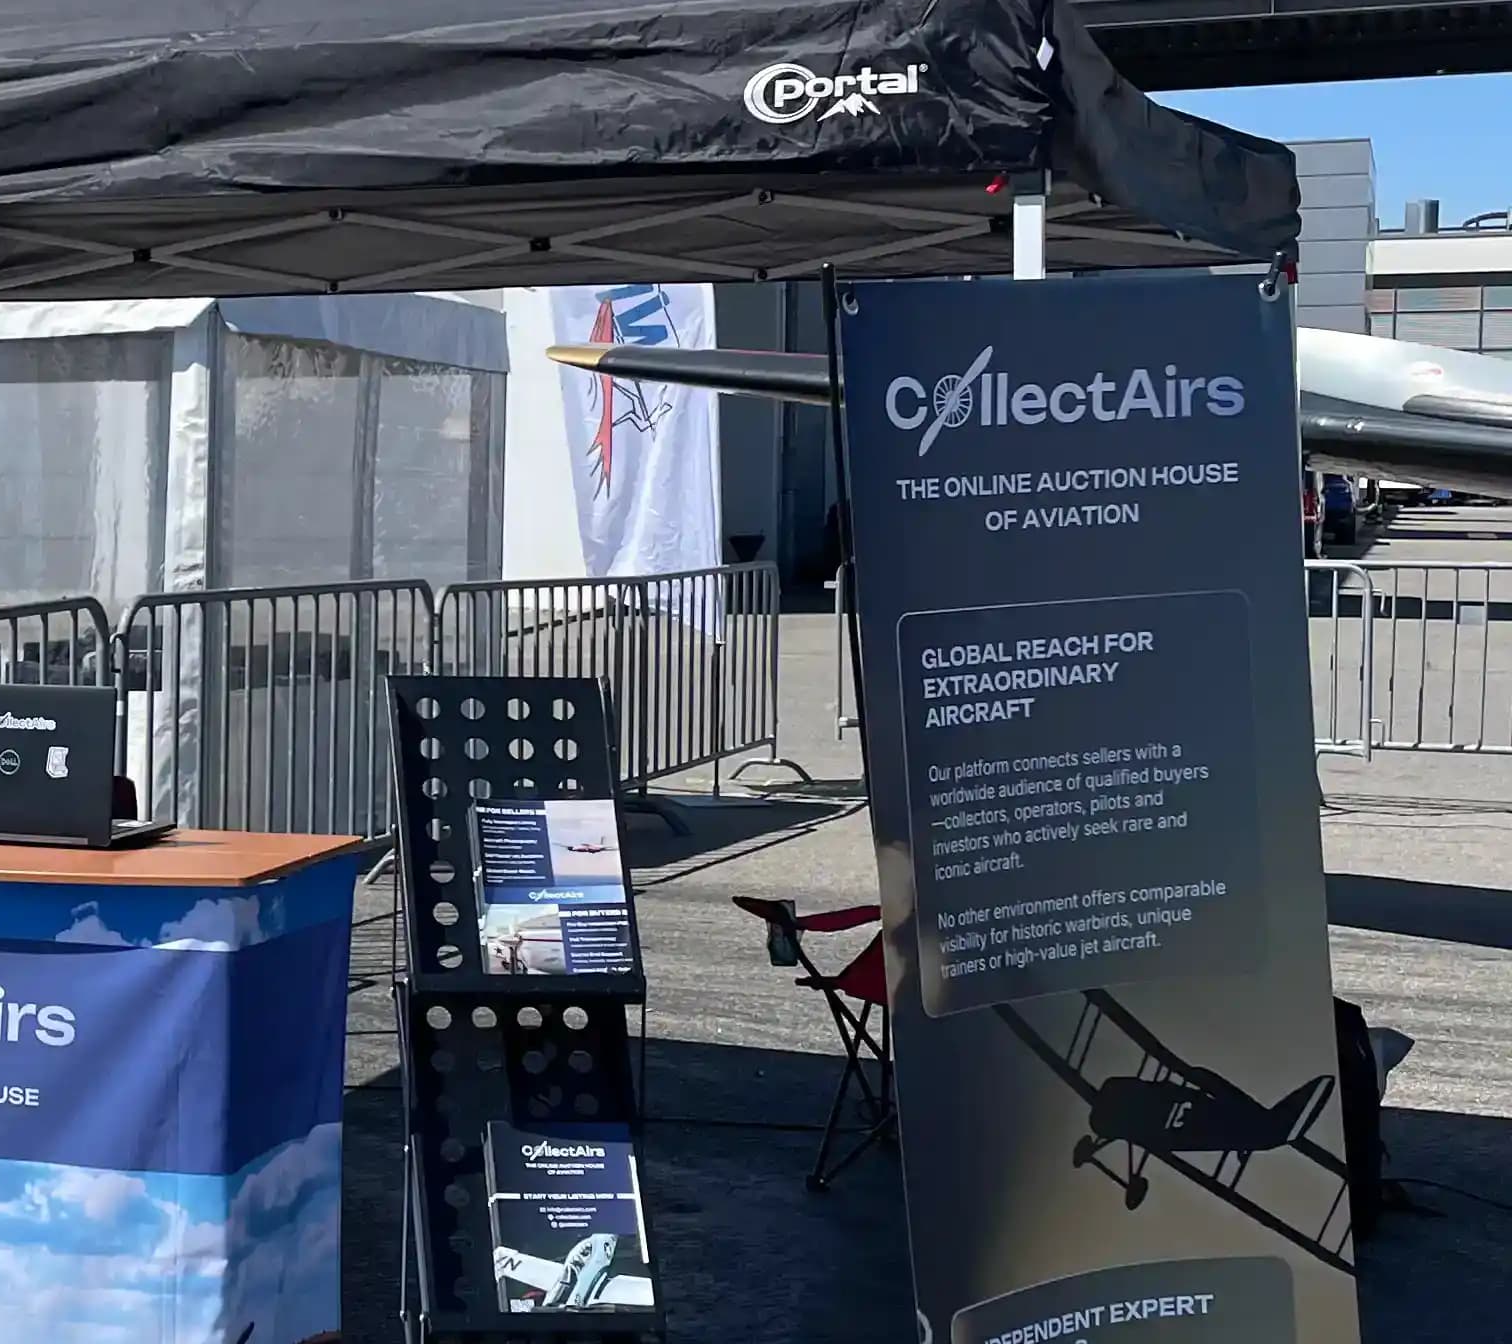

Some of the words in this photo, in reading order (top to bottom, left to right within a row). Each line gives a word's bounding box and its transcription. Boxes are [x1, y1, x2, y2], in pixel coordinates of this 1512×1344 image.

[774, 63, 919, 108] portal
[885, 345, 1245, 457] CollectAirs
[896, 478, 940, 500] THE
[944, 472, 1032, 497] ONLINE
[1036, 466, 1147, 493] AUCTION
[1151, 462, 1239, 485] HOUSE
[985, 510, 1017, 532] OF
[1022, 503, 1139, 530] AVIATION
[921, 642, 1013, 670] GLOBAL
[1016, 634, 1099, 661] REACH
[1104, 631, 1154, 654] FOR
[923, 661, 1120, 699] EXTRAORDINARY
[925, 698, 1035, 728] AIRCRAFT
[928, 765, 951, 782] Our
[954, 758, 1009, 783] platform
[1013, 751, 1079, 772] connects
[1082, 747, 1131, 765] sellers
[1134, 742, 1167, 760] with
[1171, 744, 1182, 757] a
[929, 784, 996, 807] worldwide
[998, 778, 1062, 798] audience
[1066, 772, 1082, 790] of
[1085, 768, 1149, 792] qualified
[1153, 766, 1209, 785] buyers
[1014, 800, 1087, 823] operators,
[1090, 794, 1130, 816] pilots
[1134, 790, 1164, 807] and
[932, 835, 990, 856] investors
[993, 829, 1022, 847] who
[1025, 822, 1080, 842] actively
[1083, 818, 1118, 837] seek
[1122, 816, 1153, 833] rare
[1157, 811, 1188, 829] and
[934, 860, 970, 880] iconic
[973, 851, 1024, 874] aircraft.
[937, 912, 955, 930] No
[958, 907, 990, 926] other
[993, 893, 1078, 919] environment
[1082, 888, 1126, 907] offers
[1129, 879, 1227, 903] comparable
[939, 932, 987, 954] visibility
[990, 927, 1008, 944] for
[1012, 919, 1062, 942] historic
[1064, 911, 1133, 934] warbirds,
[1137, 907, 1192, 927] unique
[940, 958, 986, 979] trainers
[989, 955, 1002, 969] or
[1005, 942, 1077, 968] high-value
[1080, 939, 1099, 960] jet
[1102, 930, 1161, 953] aircraft.
[1109, 1294, 1214, 1324] EXPERT
